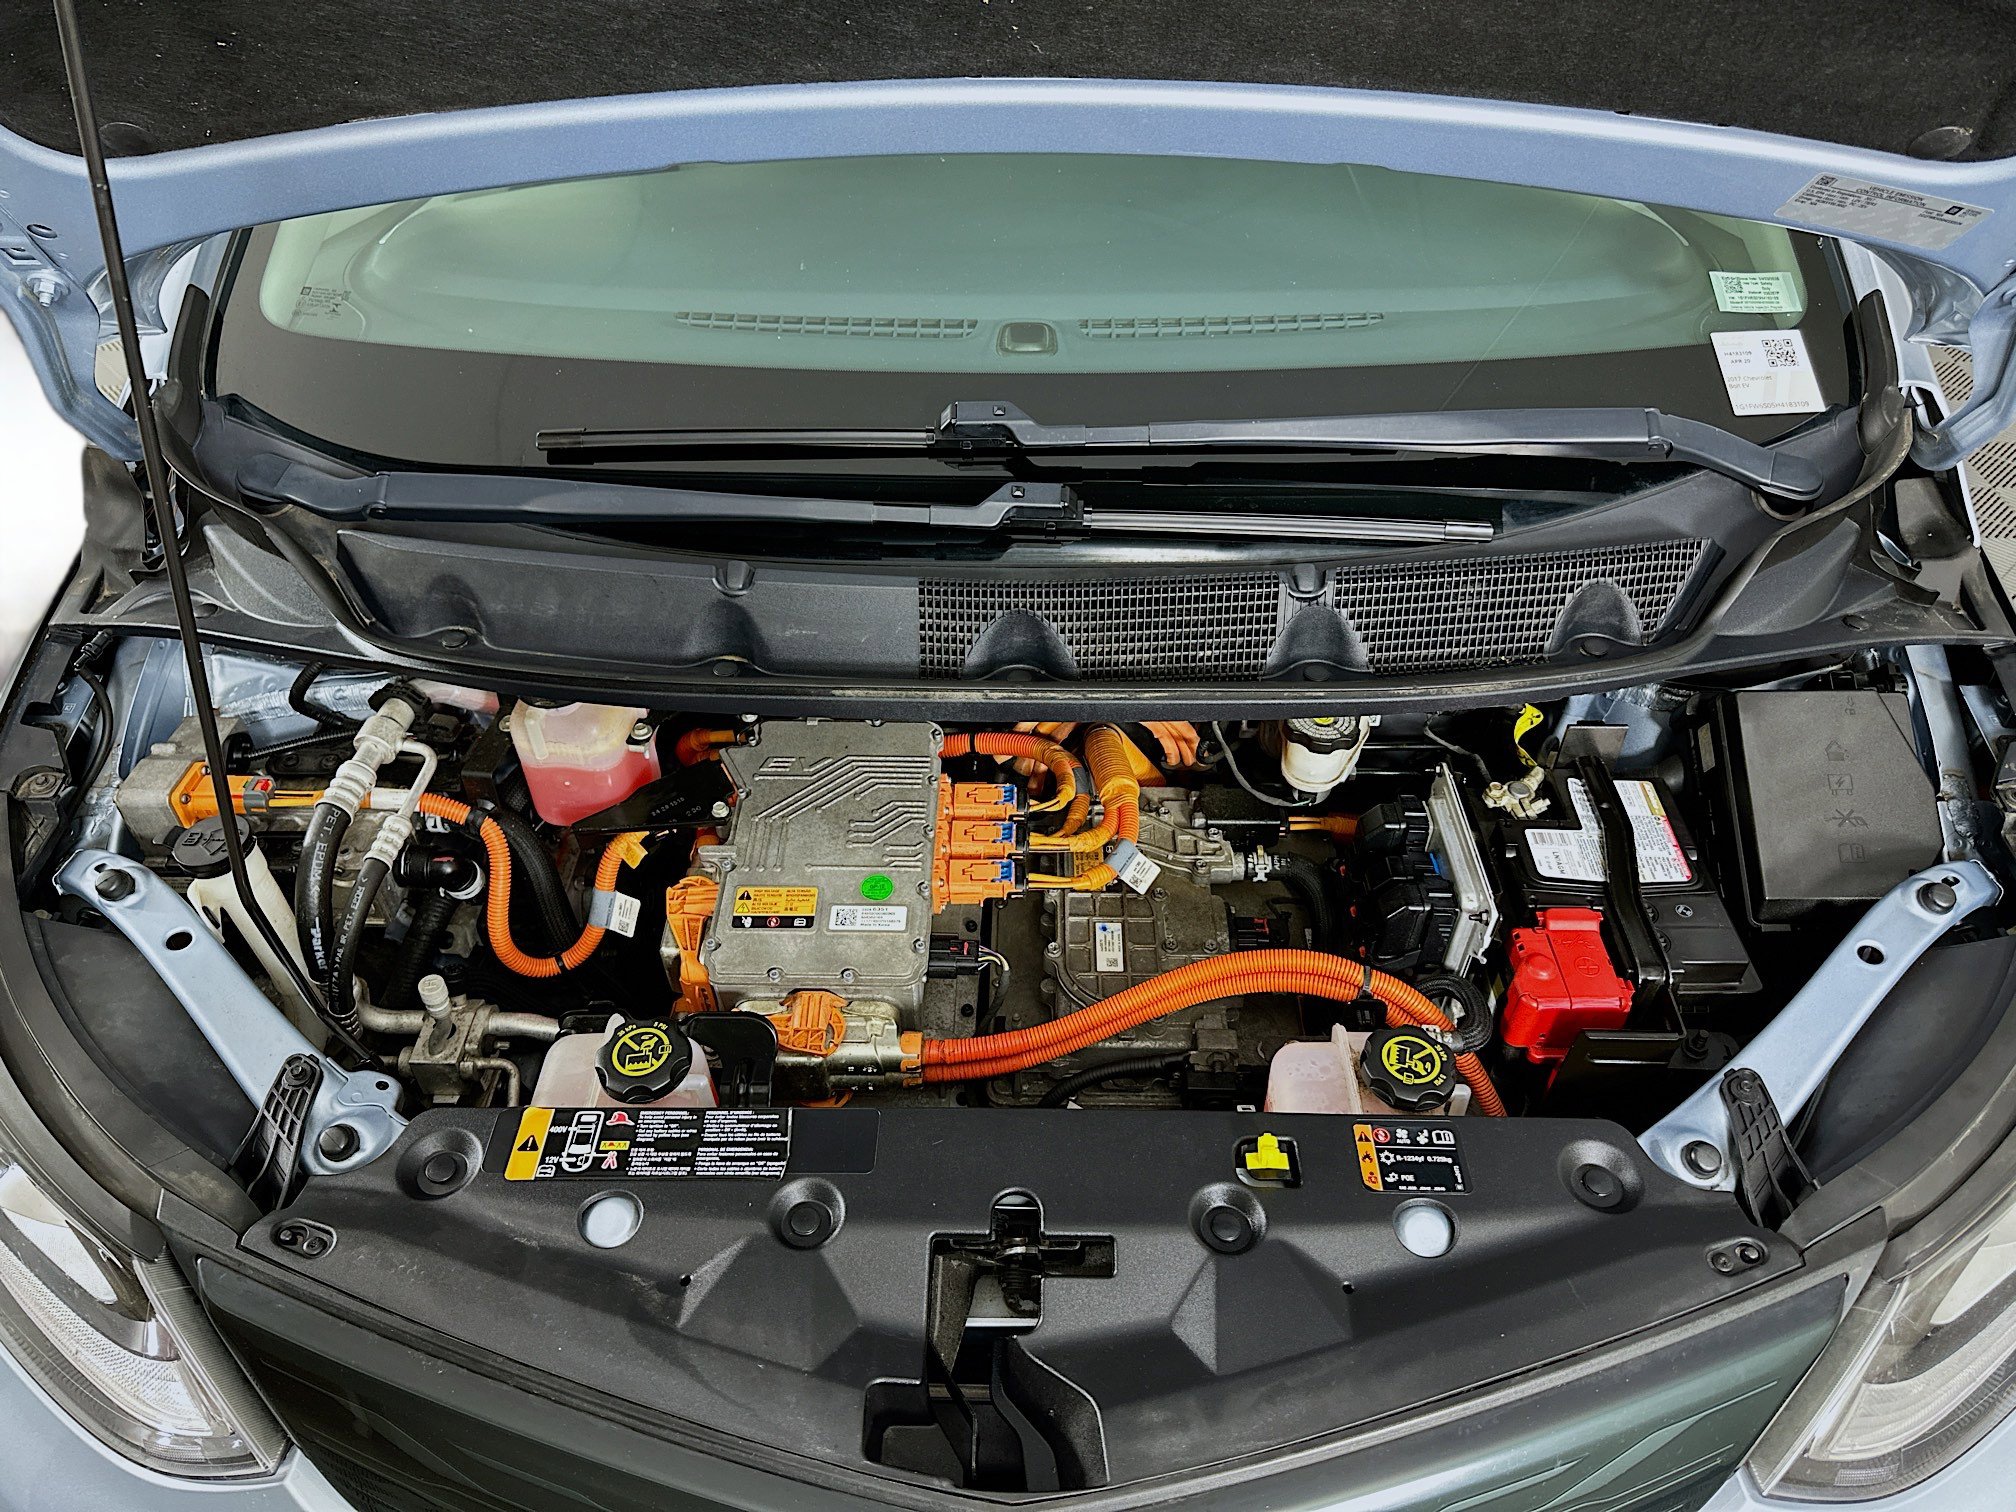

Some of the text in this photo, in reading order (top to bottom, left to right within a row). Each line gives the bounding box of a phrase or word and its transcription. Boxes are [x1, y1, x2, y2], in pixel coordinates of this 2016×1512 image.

[1856, 189, 1884, 199] CONTROL
[1885, 194, 1927, 207] INFORMATION
[1869, 186, 1925, 201] VEHICLE EMISSION
[624, 1024, 637, 1033] kPa
[657, 1022, 668, 1030] PSI
[1433, 1077, 1445, 1087] PSI
[549, 1125, 568, 1134] 400V
[545, 1156, 560, 1164] 12V
[1396, 1155, 1424, 1163] R-1234yf
